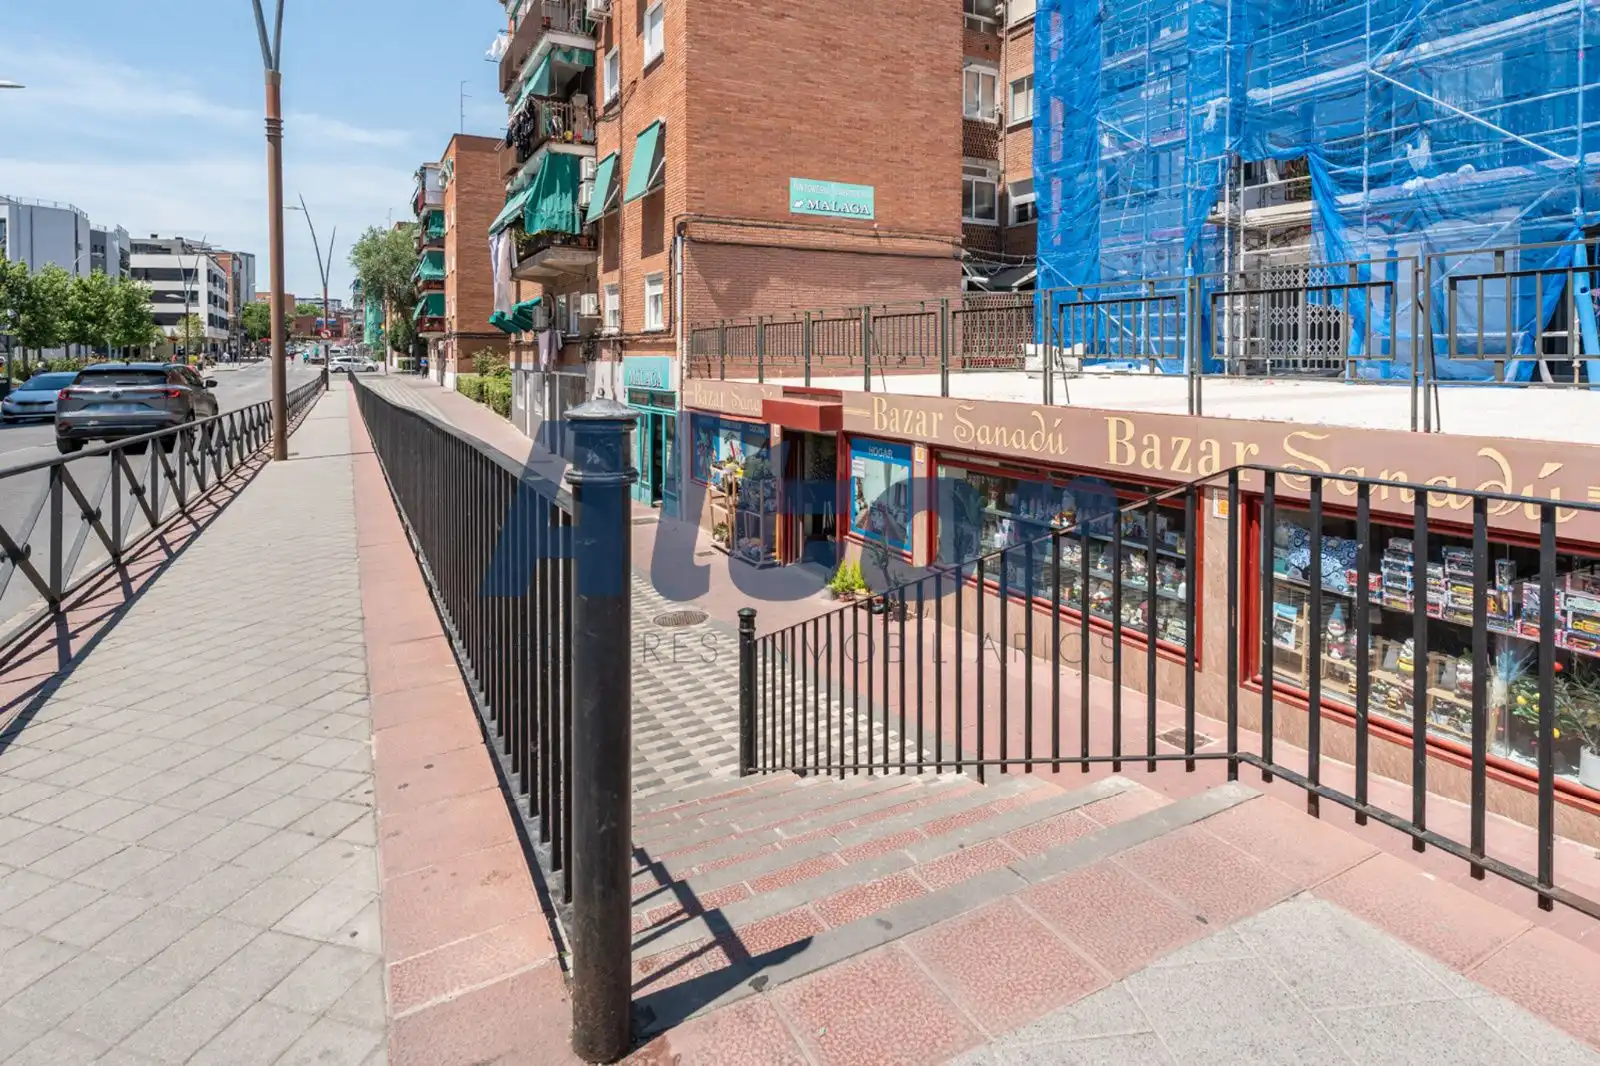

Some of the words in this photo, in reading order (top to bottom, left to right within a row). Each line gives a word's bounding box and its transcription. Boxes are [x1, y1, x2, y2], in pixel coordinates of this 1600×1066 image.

[694, 383, 725, 408] Bazar
[872, 396, 944, 438] Bazar
[953, 404, 1069, 455] Sanadú
[868, 447, 893, 460] HOGAR
[1104, 416, 1259, 483] Bazar
[1278, 430, 1580, 523] Sanadú
